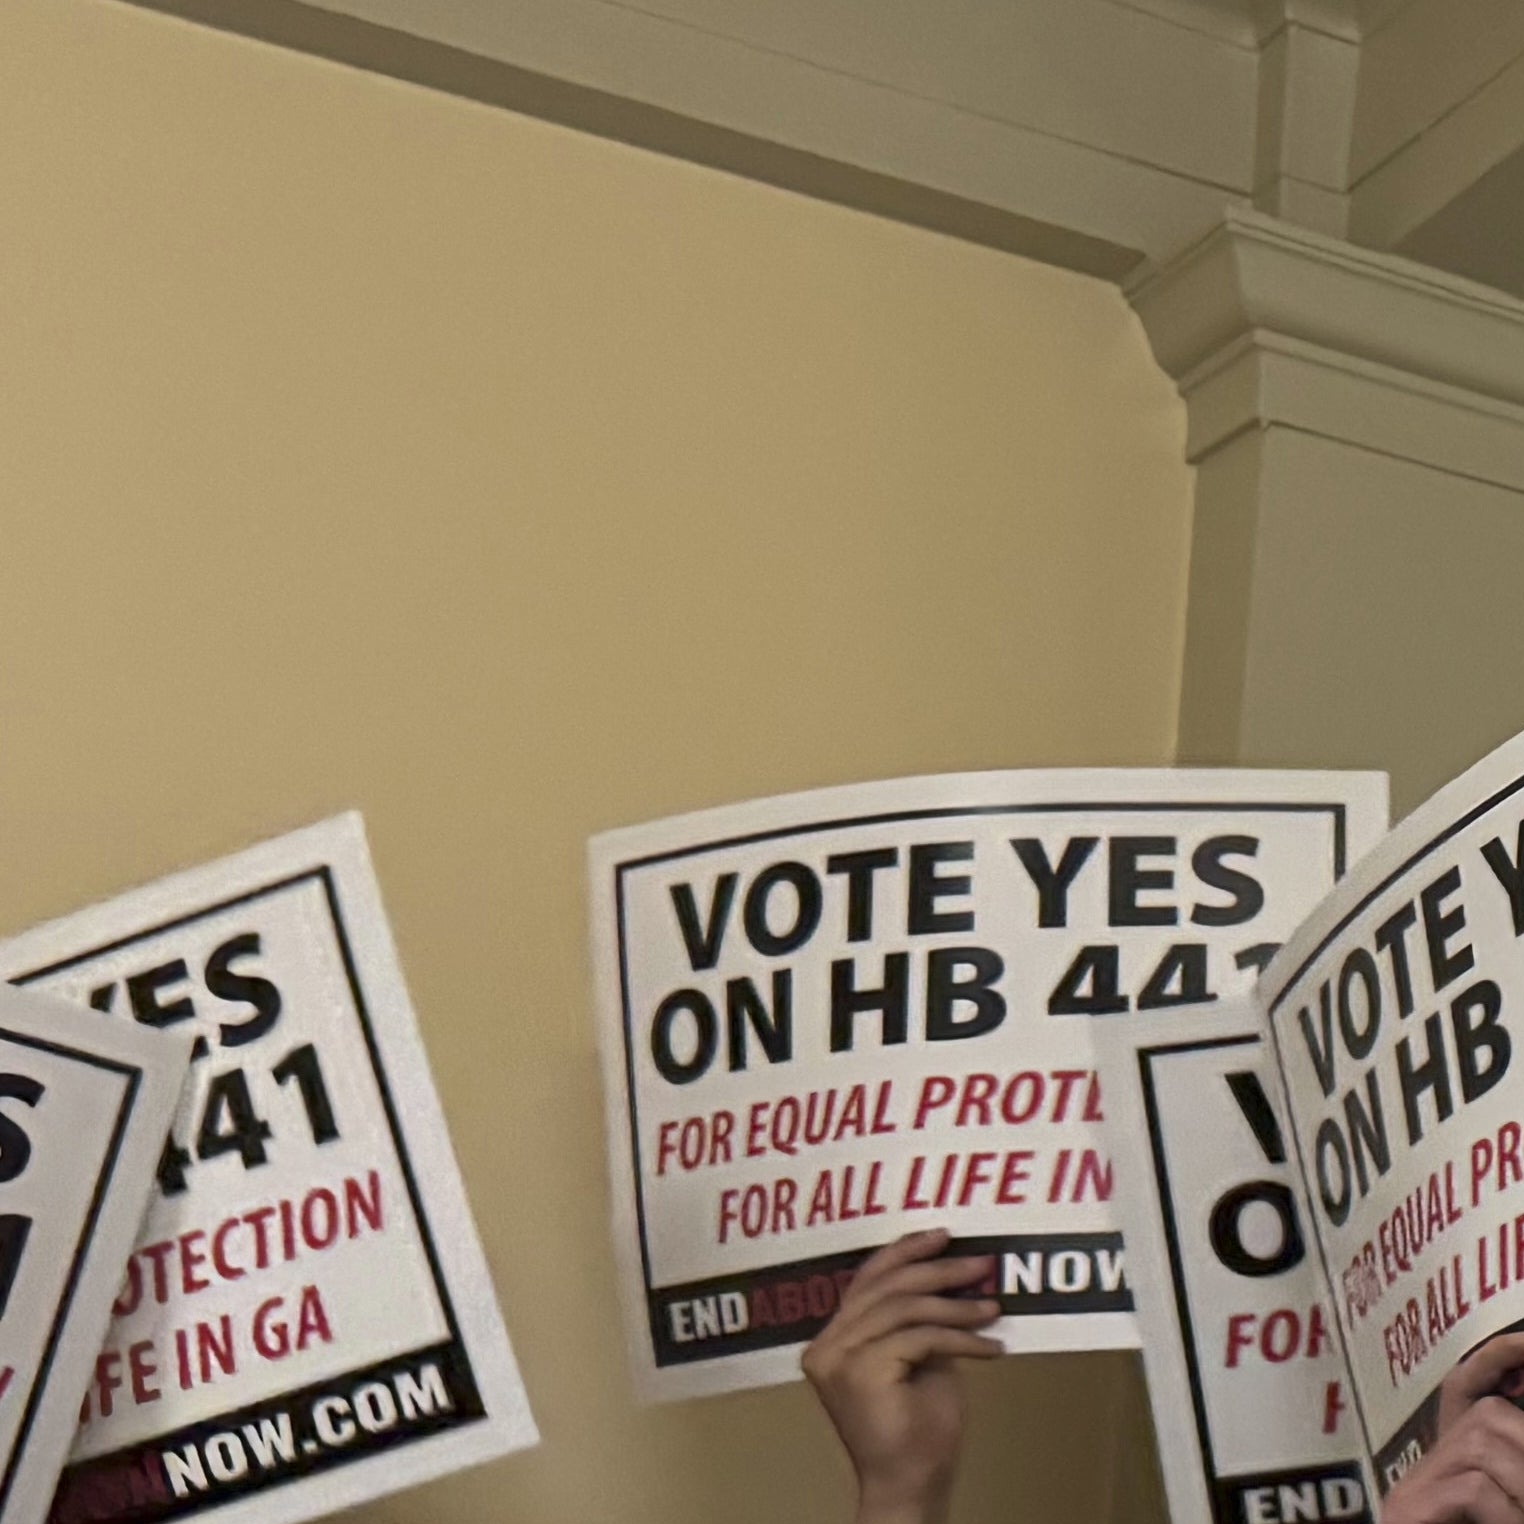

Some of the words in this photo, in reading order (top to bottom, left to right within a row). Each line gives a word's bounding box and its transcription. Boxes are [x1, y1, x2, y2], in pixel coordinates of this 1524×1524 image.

[669, 838, 976, 972] VOTE
[1010, 834, 1266, 930] YES
[650, 970, 794, 1087] ON
[828, 945, 1008, 1055] HB
[1298, 866, 1476, 1098] VOTE
[655, 1112, 734, 1178] FOR
[746, 1078, 897, 1159] EQUAL
[1313, 1067, 1392, 1228] ON
[1396, 979, 1513, 1147] HB
[716, 1179, 798, 1246] FOR
[805, 1161, 884, 1228] ALL
[901, 1149, 1033, 1213] LIFE
[1377, 1160, 1463, 1287] EQUAL
[175, 1314, 237, 1391] IN
[251, 1284, 333, 1362] GA
[1425, 1254, 1471, 1347] ALL
